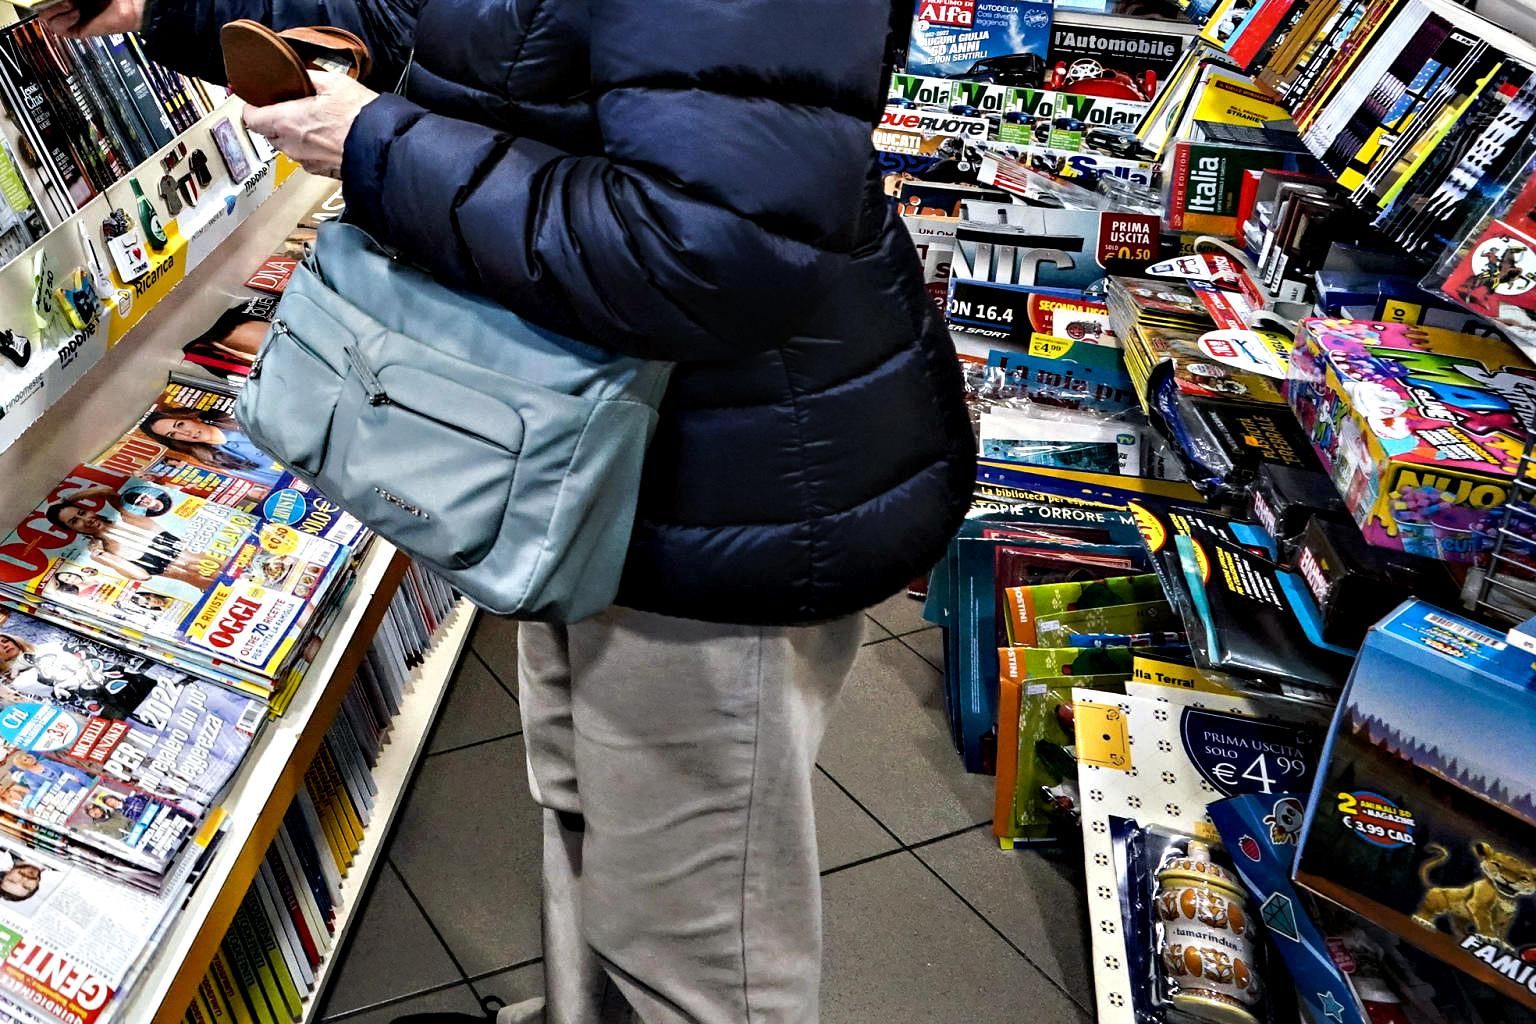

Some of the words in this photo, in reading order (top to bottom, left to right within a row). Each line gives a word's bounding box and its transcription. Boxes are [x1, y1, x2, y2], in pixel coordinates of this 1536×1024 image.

[919, 3, 972, 25] Alfa
[1112, 221, 1150, 233] PRIMA
[1111, 232, 1150, 244] USCITA
[1039, 507, 1105, 523] ORRORE
[208, 594, 263, 649] OGGI
[1204, 731, 1248, 748] PRIMA
[1252, 740, 1304, 758] USCITA
[1205, 745, 1238, 759] SOLO
